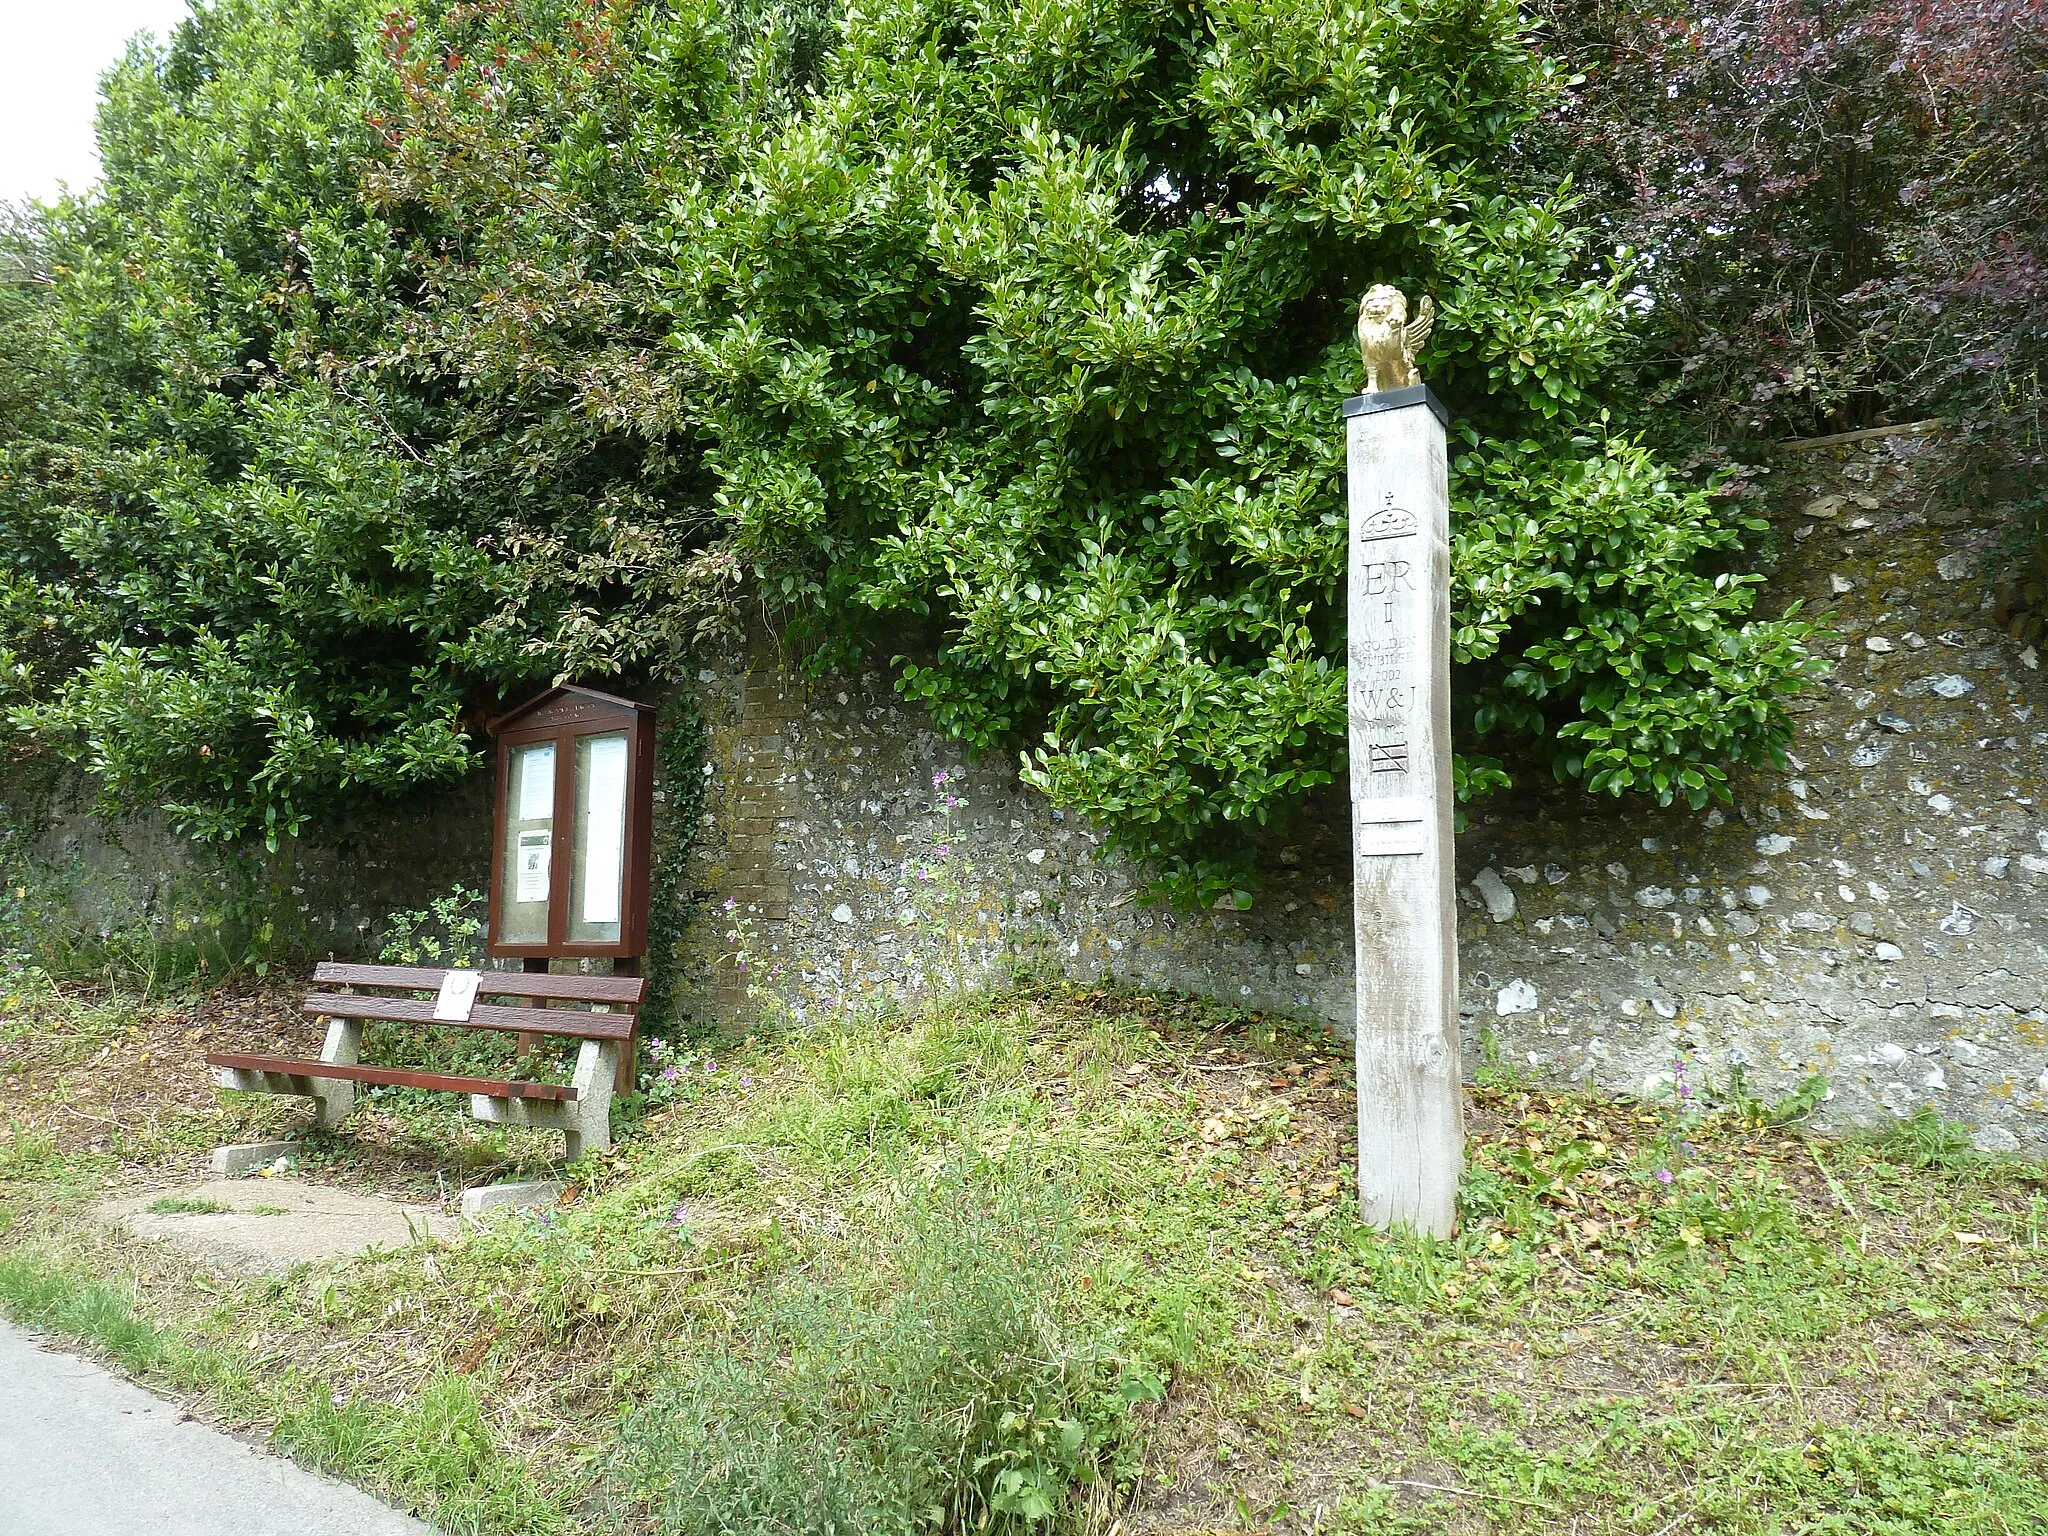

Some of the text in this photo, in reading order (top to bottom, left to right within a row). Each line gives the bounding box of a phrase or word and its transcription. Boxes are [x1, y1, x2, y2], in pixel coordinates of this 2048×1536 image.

[1361, 560, 1416, 597] ER
[1362, 636, 1415, 652] GOLDEN
[1358, 652, 1414, 669] JUBILEE
[1376, 669, 1401, 682] 2002
[1360, 686, 1417, 712] W & J
